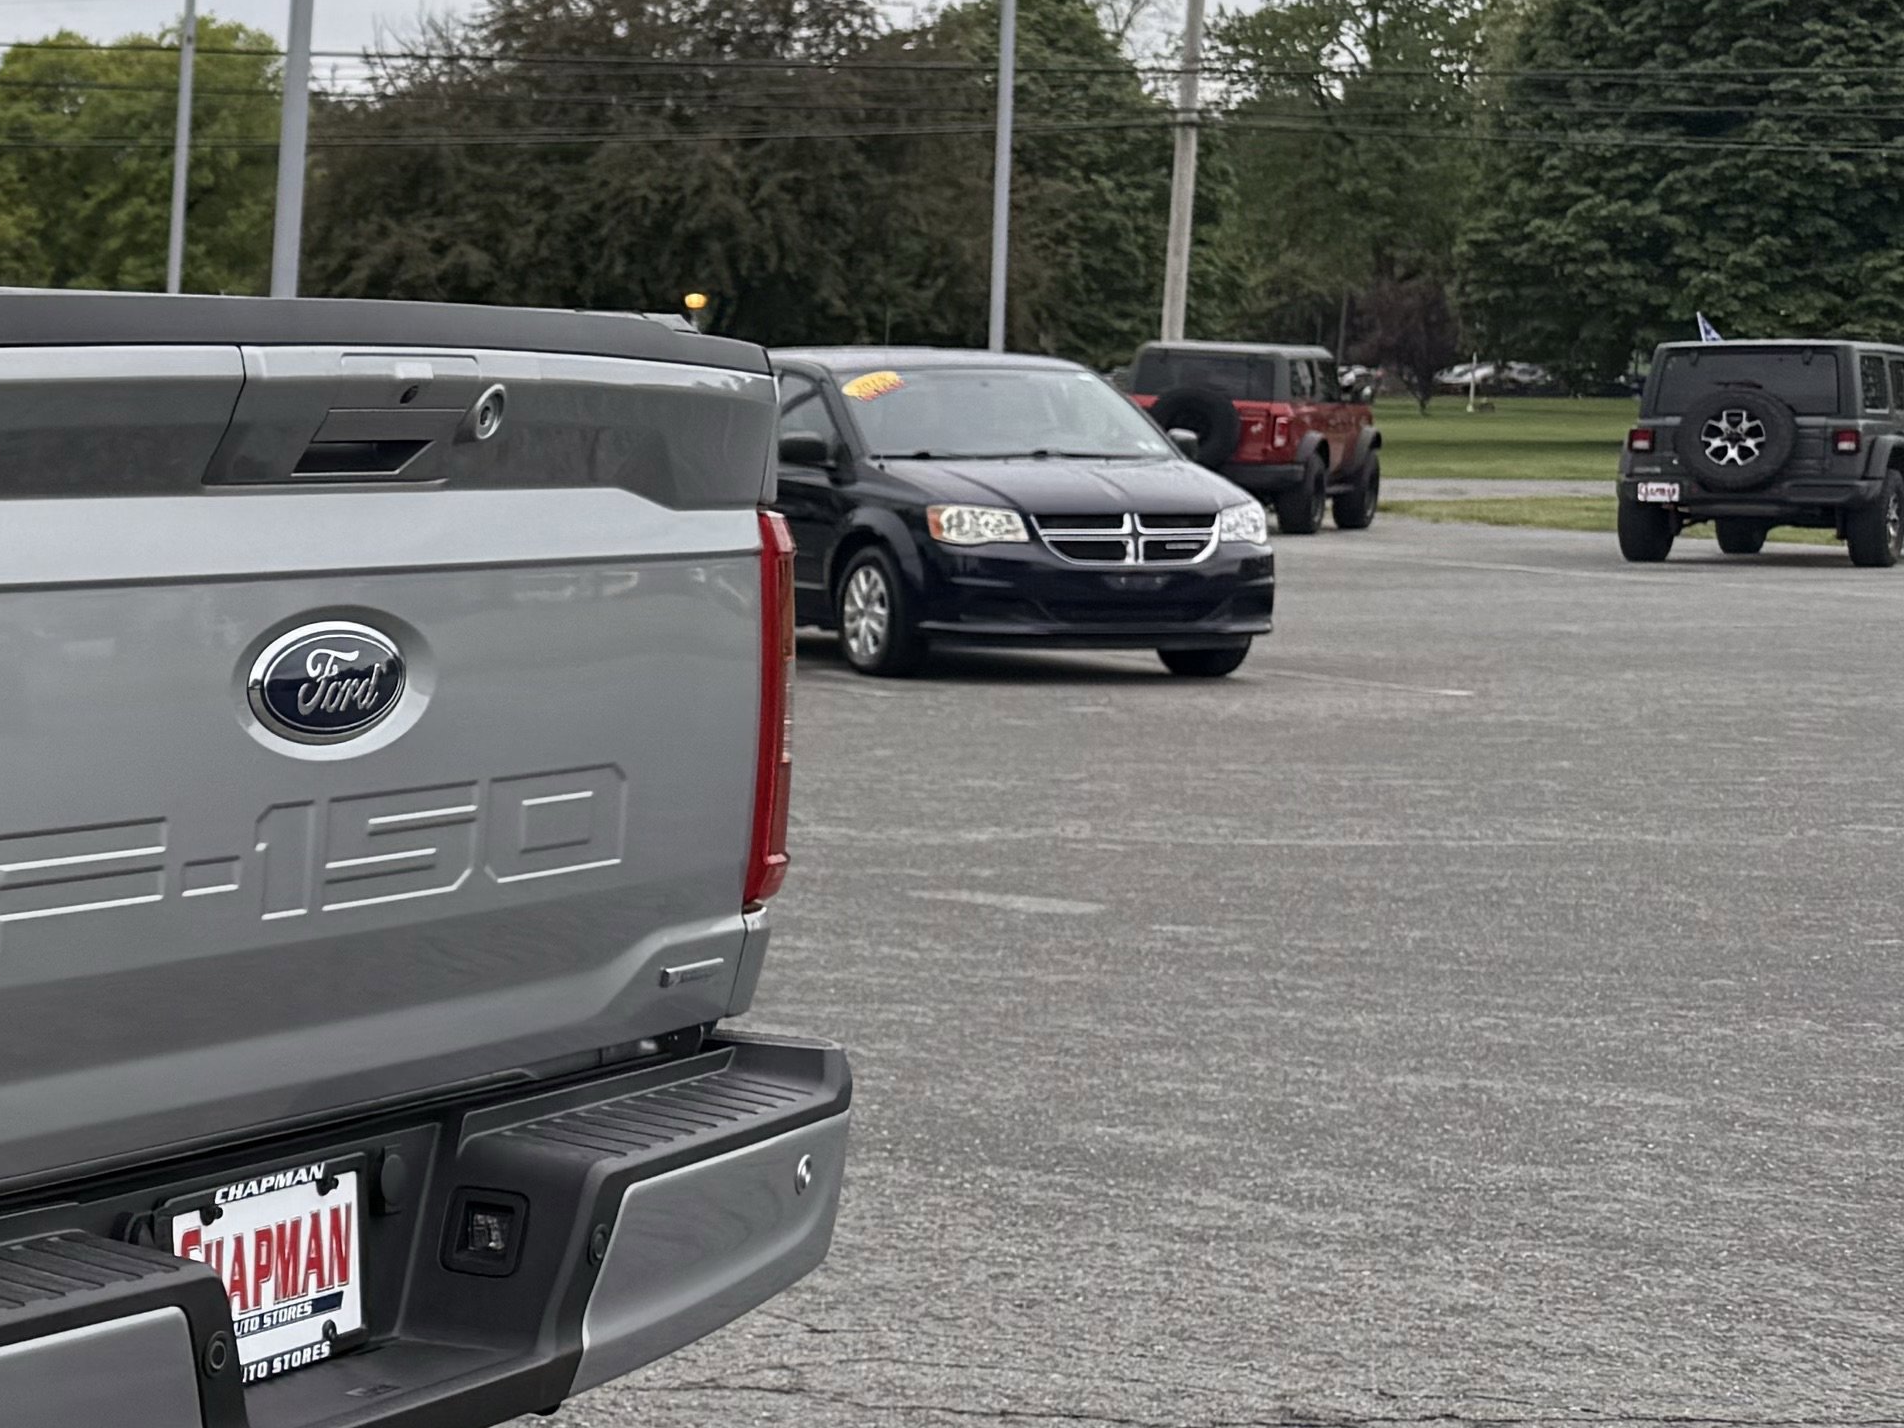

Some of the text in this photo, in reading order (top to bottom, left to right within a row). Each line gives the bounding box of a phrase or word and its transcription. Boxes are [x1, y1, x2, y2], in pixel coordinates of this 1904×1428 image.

[297, 648, 380, 716] Ford
[214, 1161, 326, 1205] CHAPMAN
[234, 1300, 314, 1337] UTO STORES
[271, 1340, 332, 1374] STORES
